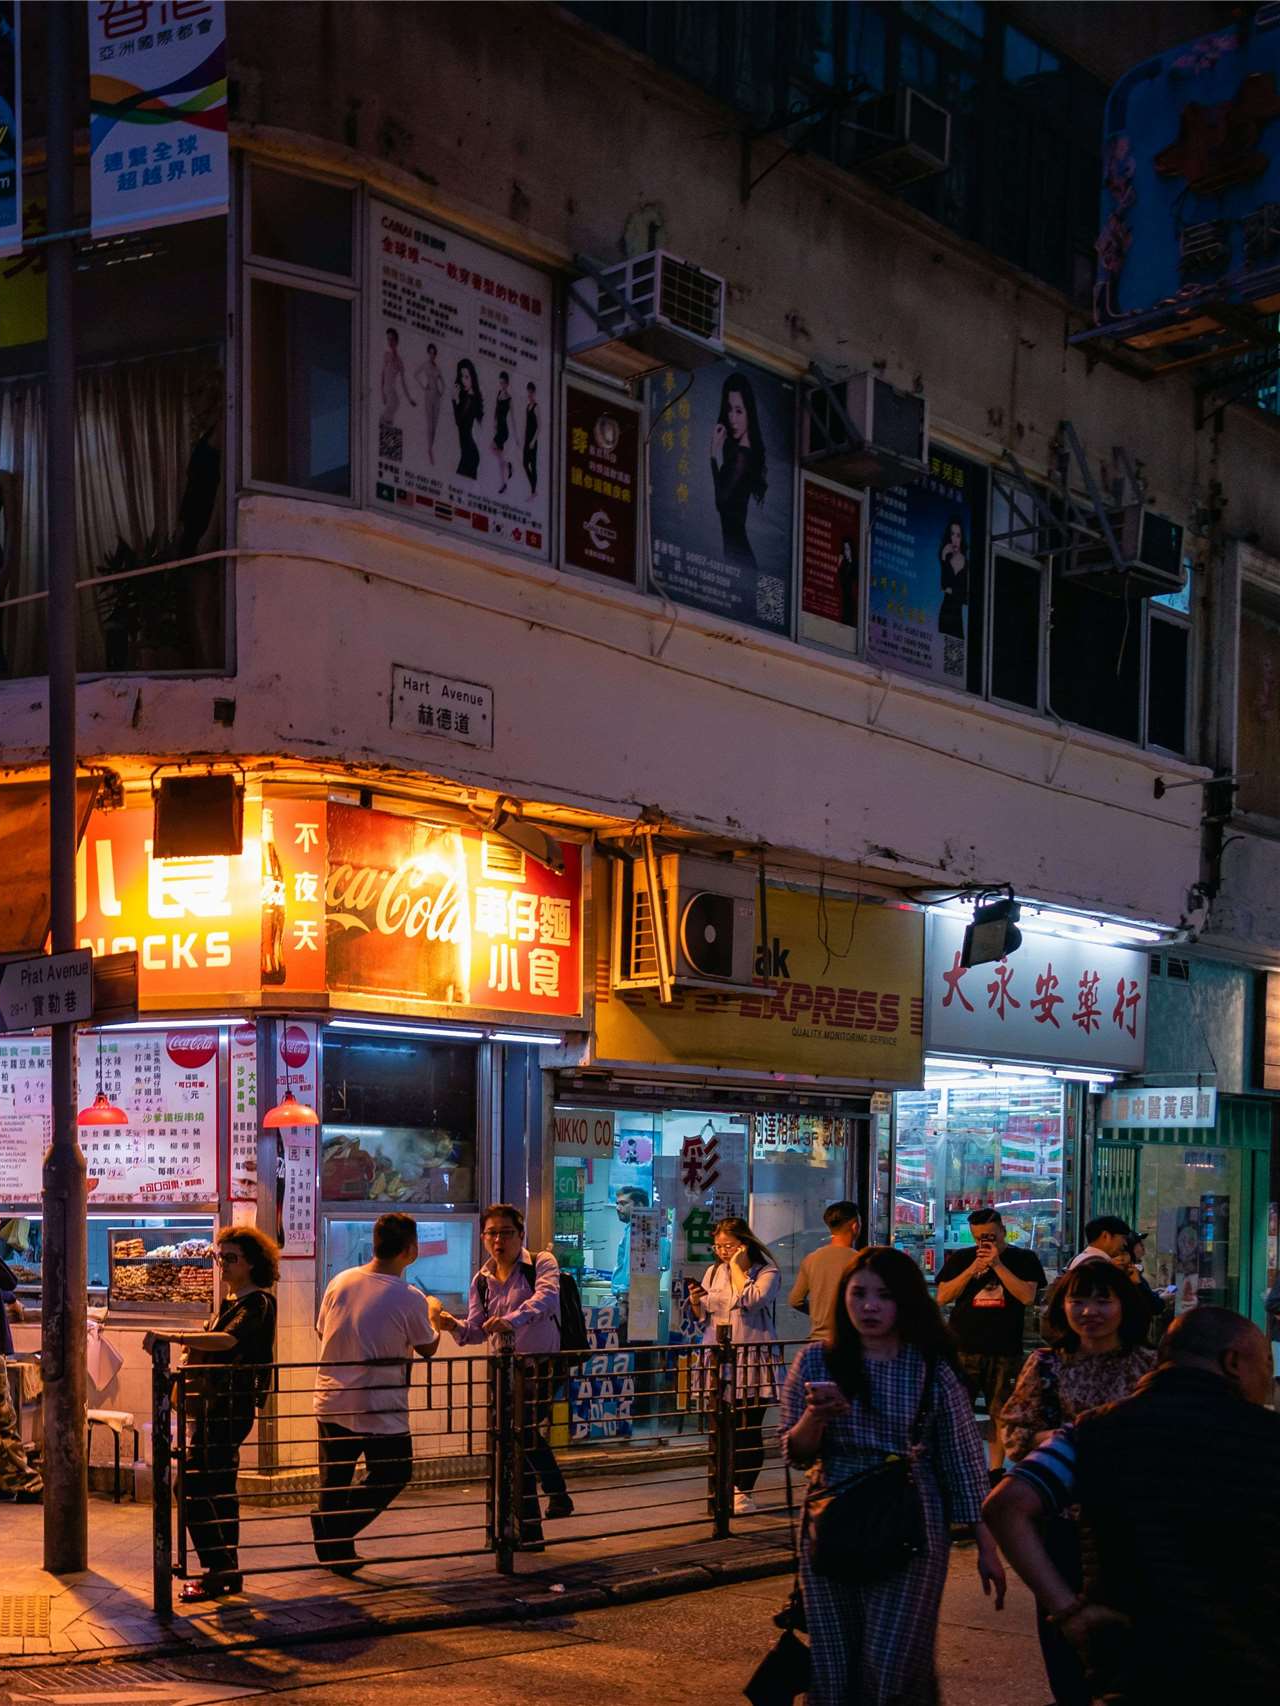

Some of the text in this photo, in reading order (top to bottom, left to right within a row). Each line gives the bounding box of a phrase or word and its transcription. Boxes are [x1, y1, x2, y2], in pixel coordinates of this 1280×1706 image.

[99, 19, 213, 61] 亞洲國際都會
[117, 154, 212, 192] 超越界限
[403, 676, 484, 706] Hart Avenue
[418, 703, 470, 734] 赫德道
[293, 822, 321, 951] 不夜天
[474, 886, 572, 947] 車仔麵
[21, 961, 90, 986] Prat Avenue
[488, 943, 561, 998] 小食
[755, 938, 791, 978] ak
[32, 990, 78, 1018] 寶勒巷
[739, 978, 901, 1033] EXPRESS
[941, 950, 1142, 1040] 大永安藥行
[792, 1027, 898, 1047] QUALITY MONITORING SERVICE
[552, 1117, 611, 1147] NIKKO CO
